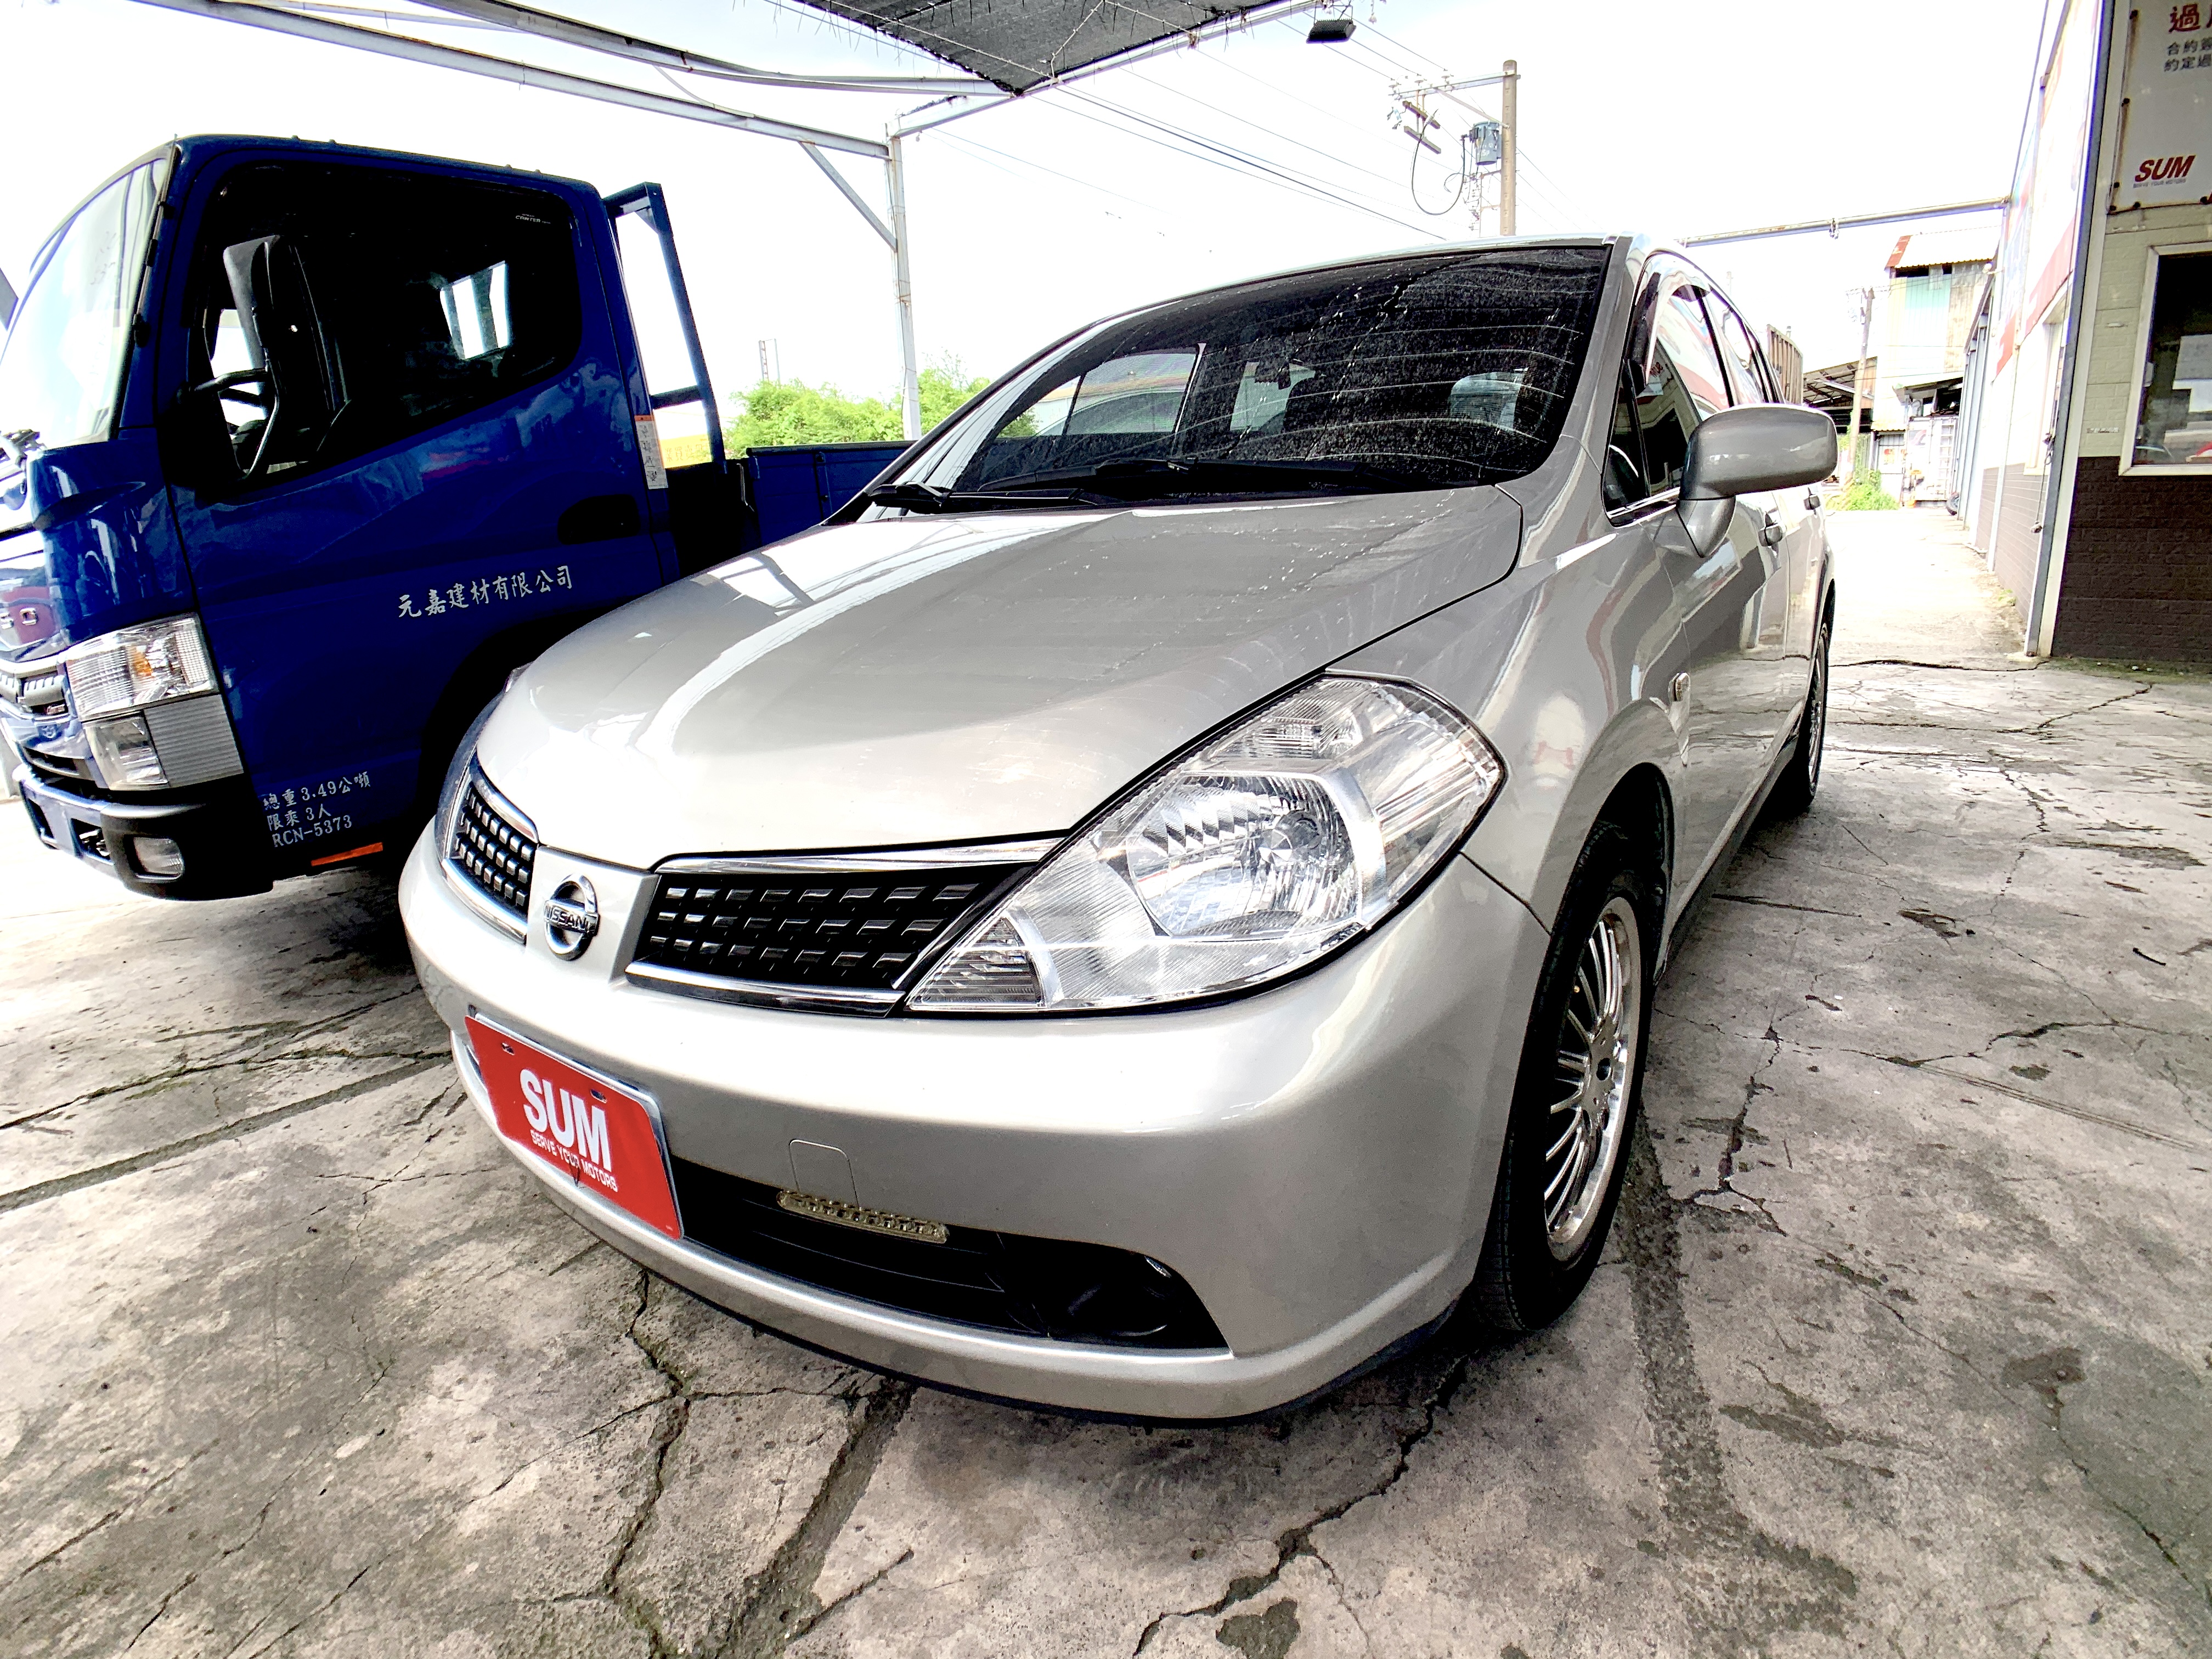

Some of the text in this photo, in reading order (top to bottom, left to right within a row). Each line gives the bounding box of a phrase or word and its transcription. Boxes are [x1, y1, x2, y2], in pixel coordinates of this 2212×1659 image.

[2135, 155, 2196, 182] SUM
[398, 565, 572, 618] 元嘉建材有限公司
[272, 815, 352, 848] RCN-5373
[544, 904, 588, 931] NISSAN
[520, 1068, 612, 1172] SUM
[530, 1129, 557, 1156] SERVE
[580, 1158, 618, 1193] MOTORS
